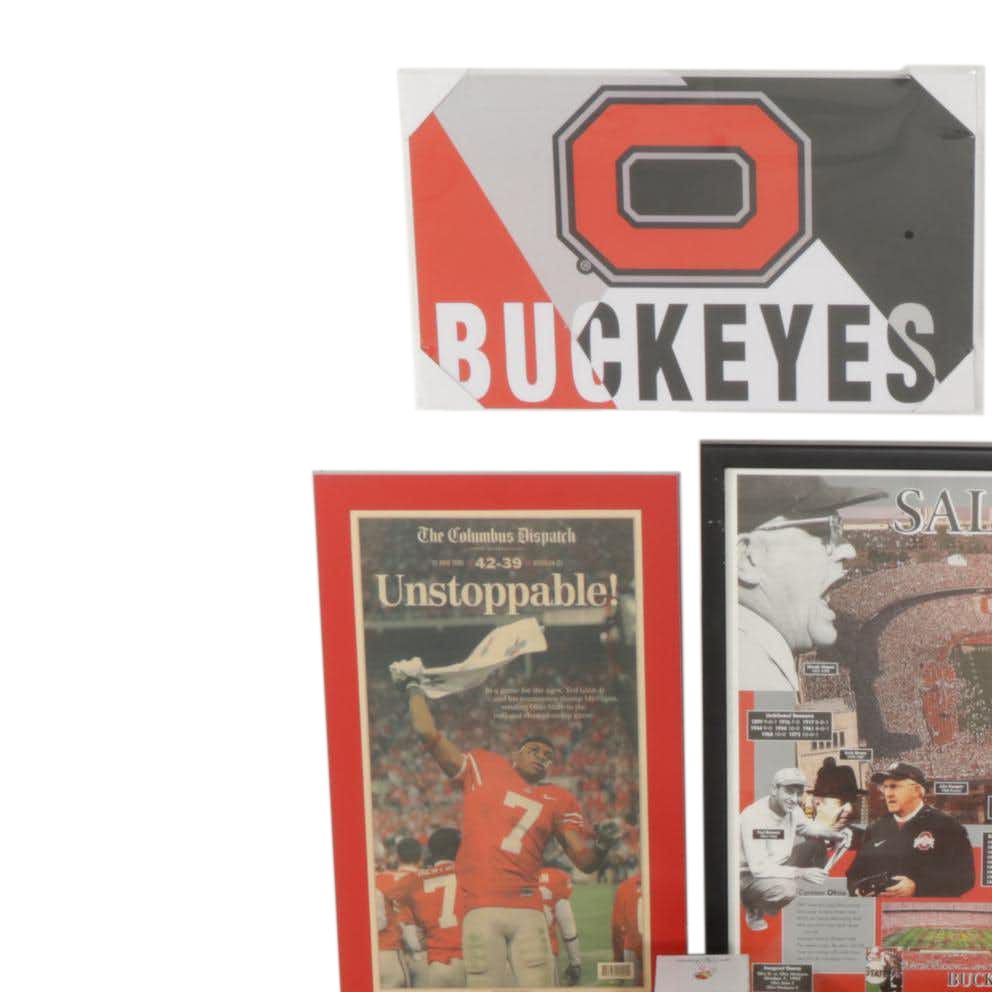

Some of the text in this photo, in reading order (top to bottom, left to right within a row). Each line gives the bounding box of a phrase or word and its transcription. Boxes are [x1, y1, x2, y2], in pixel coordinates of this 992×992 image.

[435, 302, 936, 402] BUCKEYES
[416, 526, 577, 547] The Columbus Dispatch
[475, 556, 523, 569] 42-39
[375, 572, 620, 616] Unstoppable!
[503, 790, 544, 855] 7
[422, 872, 458, 929] 7
